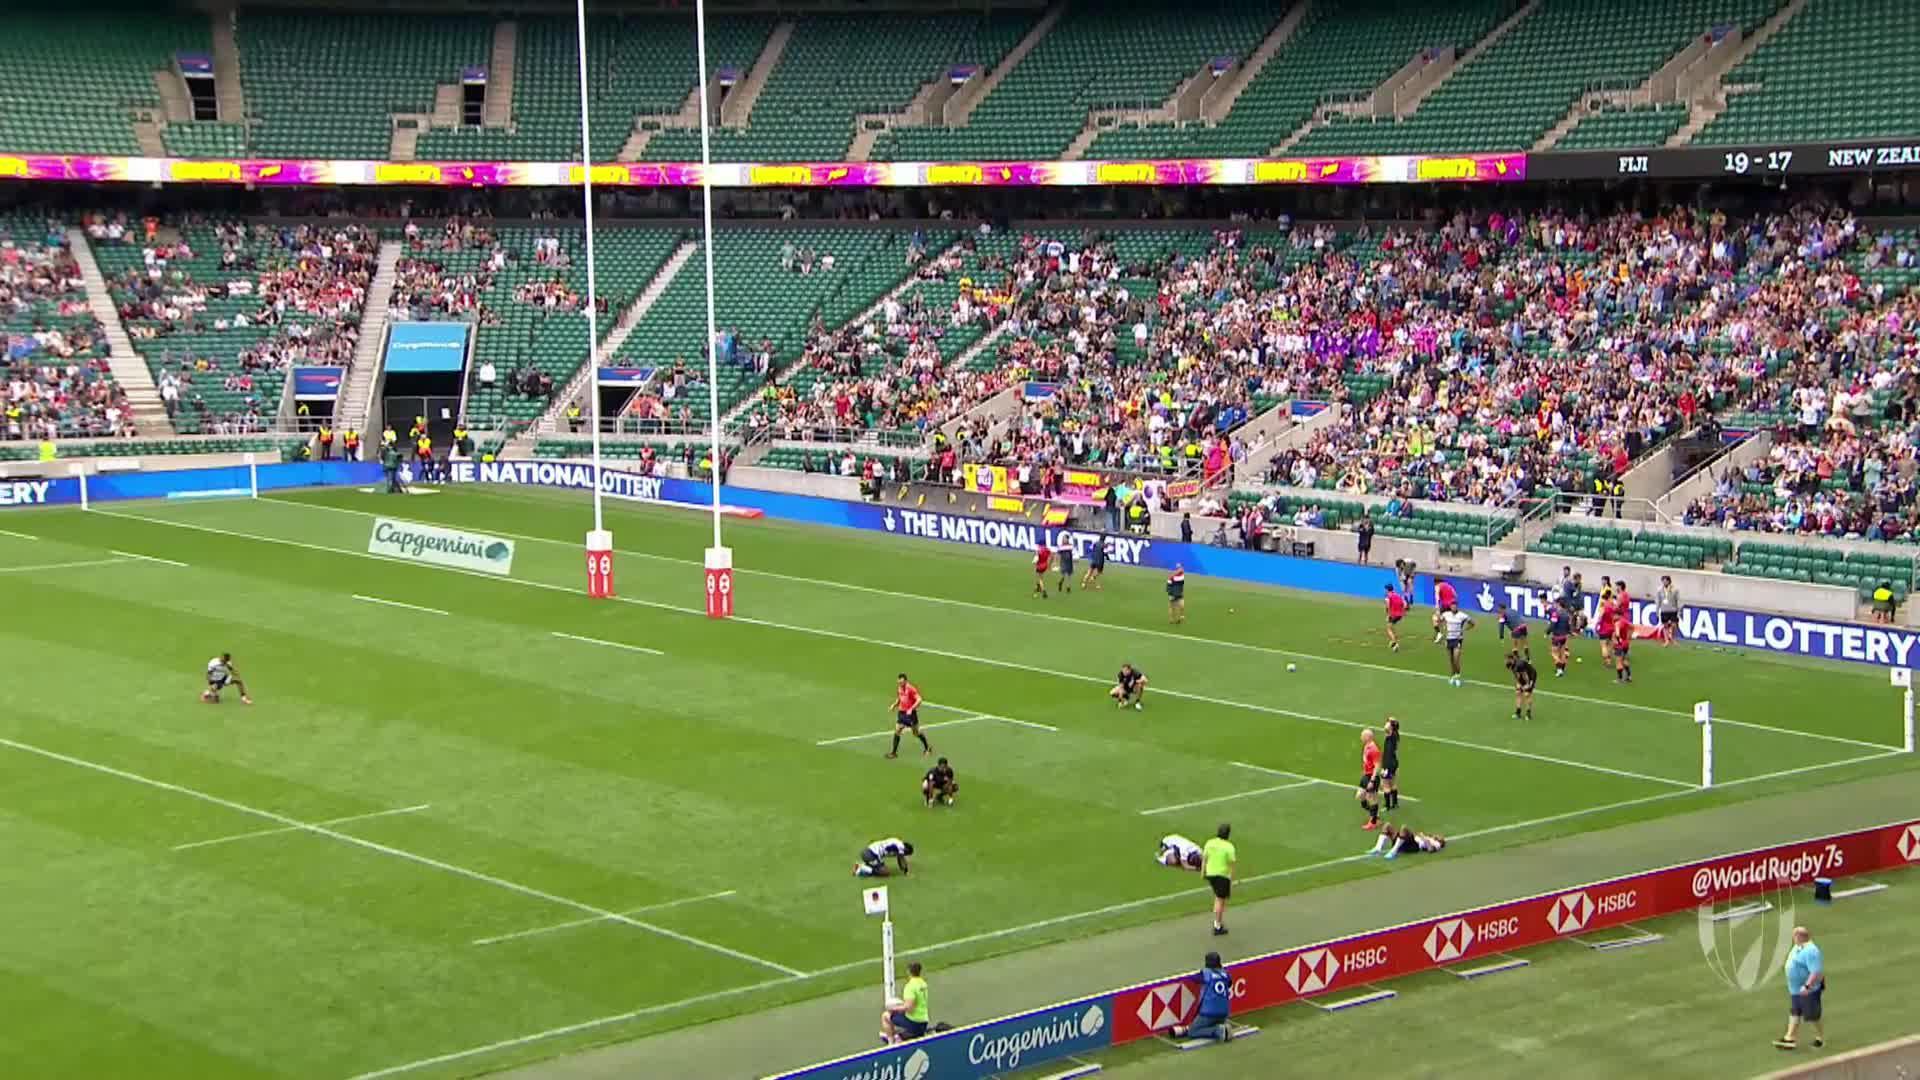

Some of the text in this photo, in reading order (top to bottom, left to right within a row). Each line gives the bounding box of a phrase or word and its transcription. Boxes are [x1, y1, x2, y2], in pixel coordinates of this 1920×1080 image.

[1618, 156, 1649, 173] FIJI
[1724, 152, 1749, 173] 19
[1767, 151, 1793, 170] 17
[1828, 148, 1874, 166] NEW
[480, 462, 595, 488] NATIONAL
[600, 470, 661, 499] OTTERY
[375, 522, 484, 559] Capgemini
[901, 510, 939, 537] THE
[941, 515, 1036, 551] NATIONAL
[1584, 595, 1738, 643] IONAL
[1745, 615, 1916, 665] LOTTERY
[1598, 890, 1637, 914] HSBC
[1477, 917, 1519, 942] HSBC
[1343, 945, 1388, 973] HSBC
[968, 1012, 1079, 1069] Capgemini
